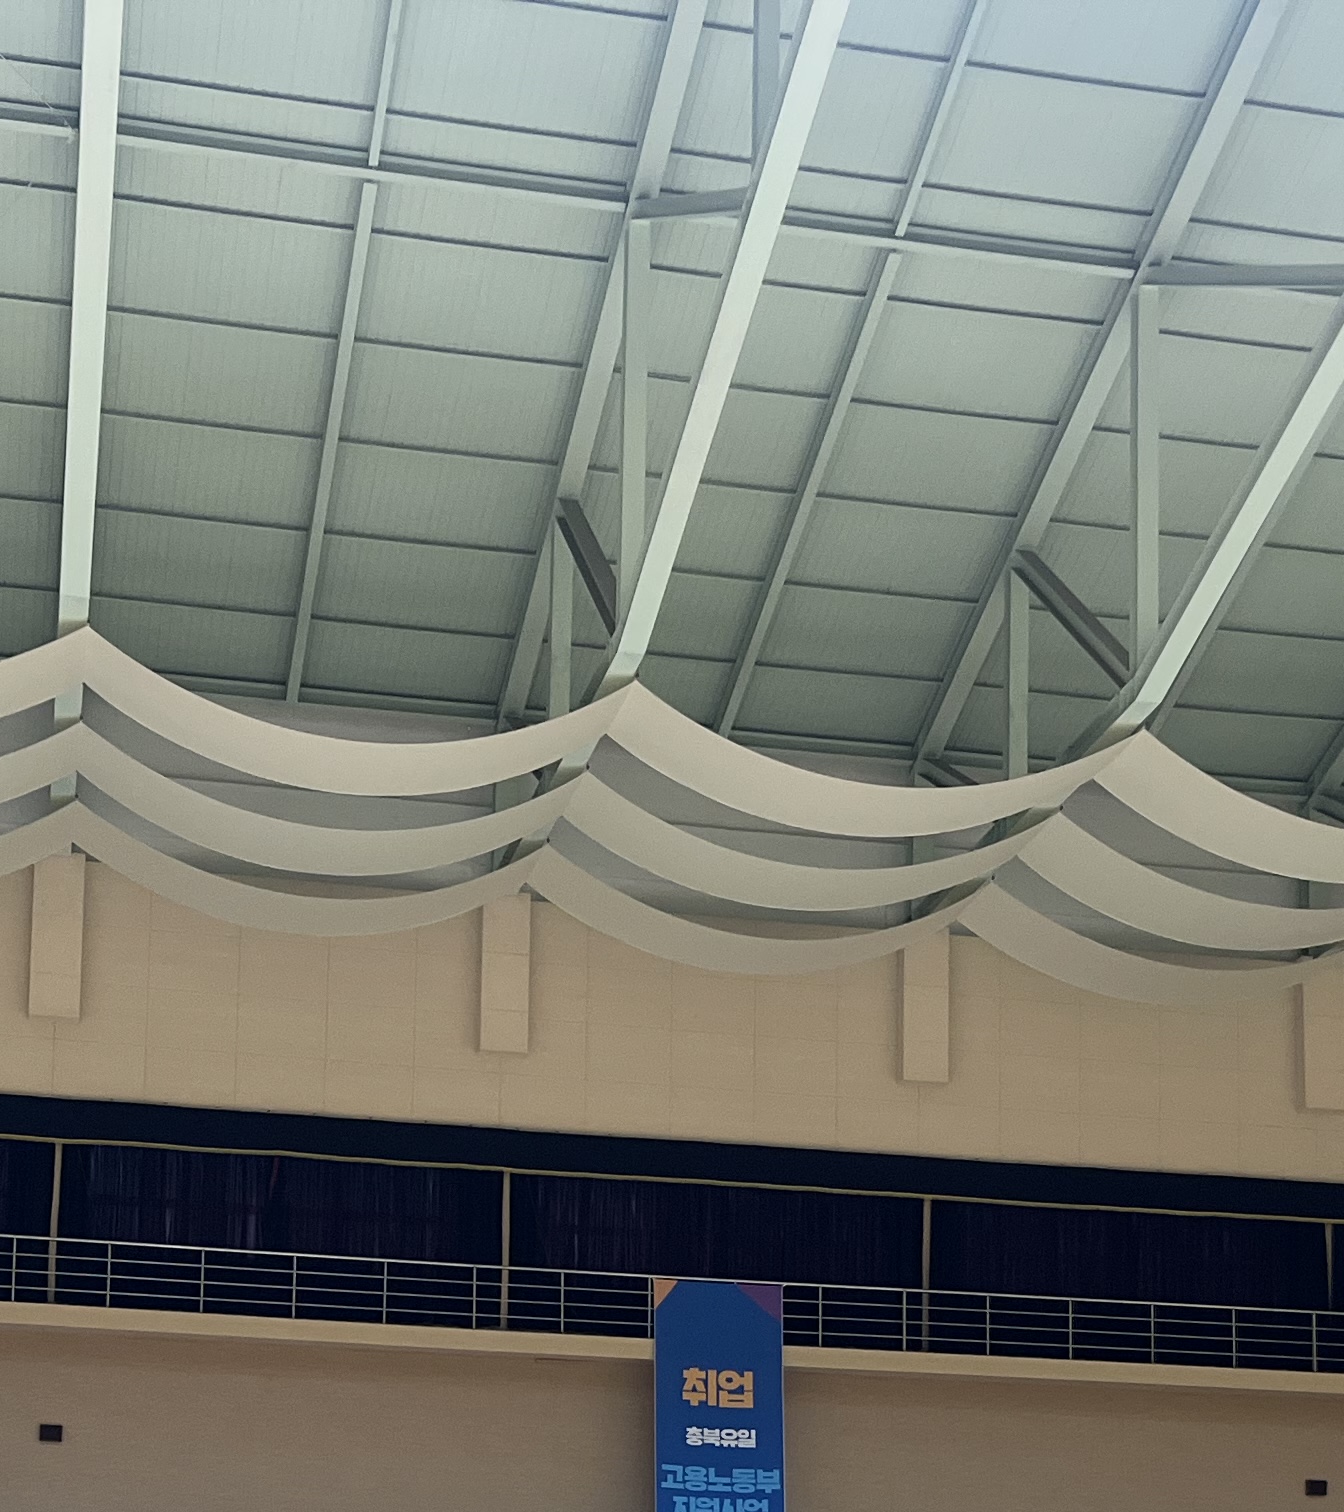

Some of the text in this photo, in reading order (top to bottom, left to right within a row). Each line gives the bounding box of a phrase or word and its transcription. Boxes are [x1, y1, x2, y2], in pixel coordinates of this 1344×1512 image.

[682, 1367, 754, 1409] 취업
[685, 1426, 756, 1448] 충북유일
[660, 1463, 781, 1494] 고용노동부
